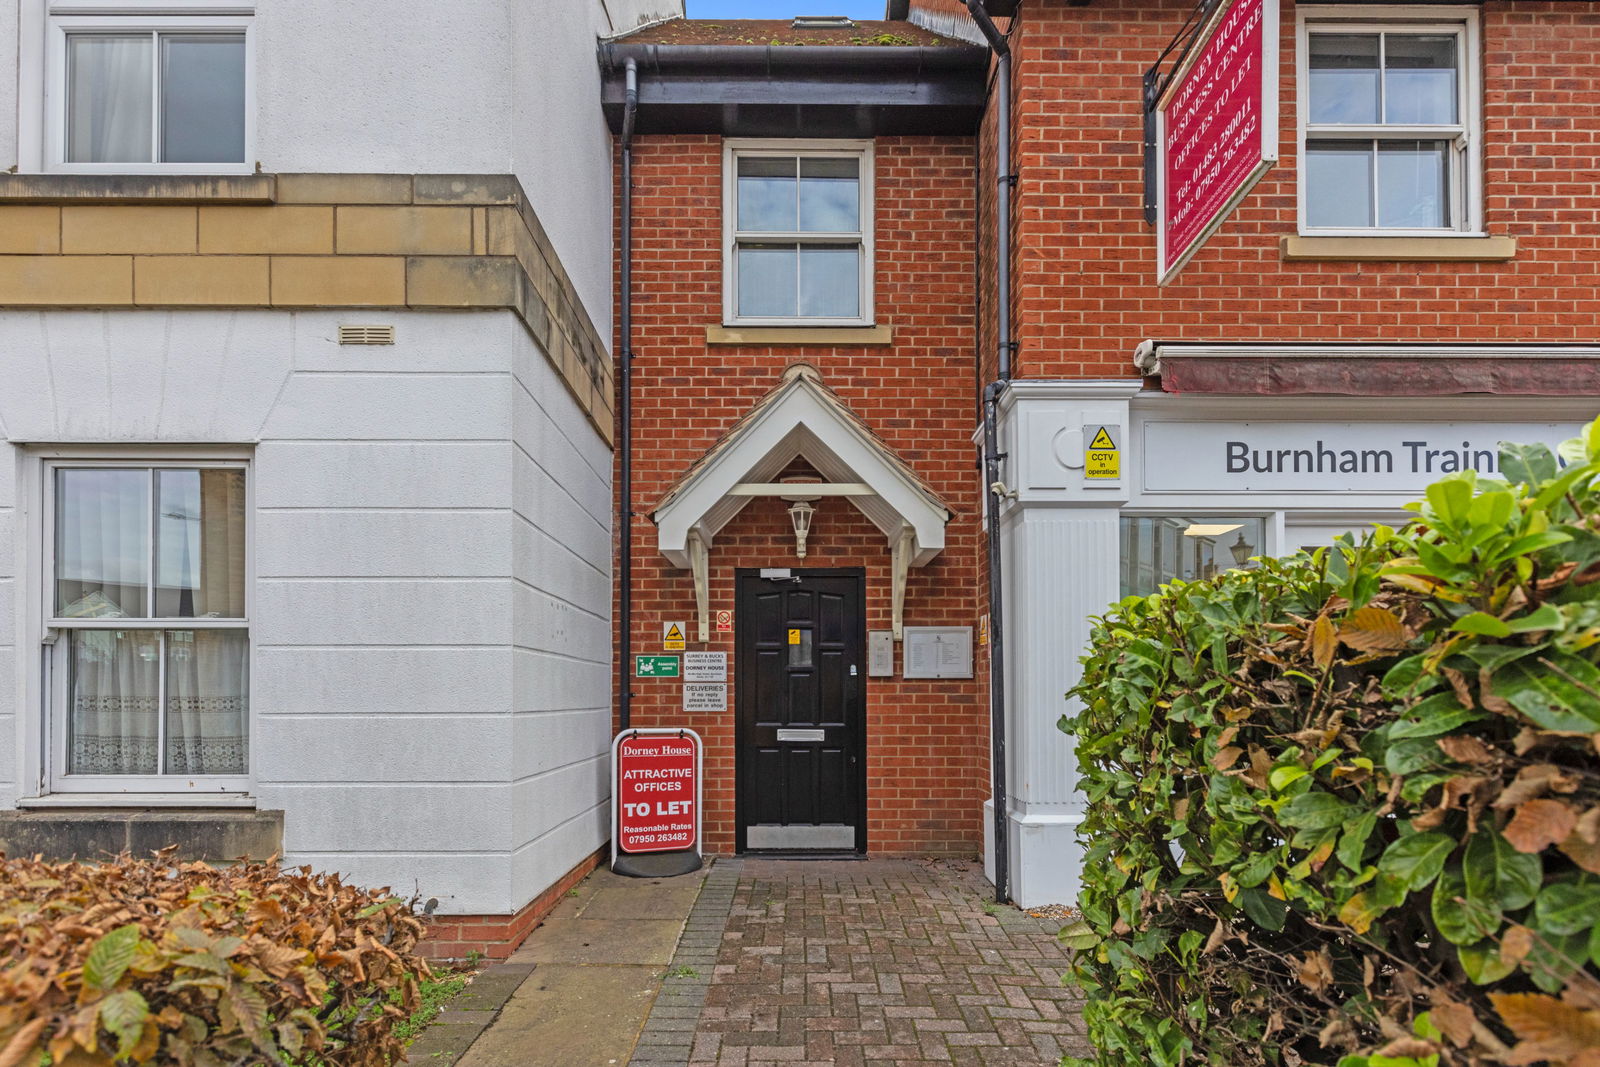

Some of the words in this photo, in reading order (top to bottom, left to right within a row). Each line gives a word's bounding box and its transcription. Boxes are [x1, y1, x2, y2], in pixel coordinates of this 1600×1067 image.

[1172, 48, 1214, 119] DORNEY
[1216, 0, 1251, 53] HOUS
[1168, 77, 1212, 151] BUSINESS
[1215, 2, 1262, 80] CENTRE
[1175, 110, 1212, 169] OFFICES
[1215, 89, 1229, 115] TO
[1231, 52, 1252, 94] LET
[1176, 181, 1191, 203] Tel:
[1192, 142, 1217, 182] 01483
[1220, 96, 1251, 149] 280011
[1173, 198, 1193, 229] Mob:
[1195, 161, 1220, 200] 07950
[1222, 115, 1256, 168] 263482
[1091, 453, 1114, 461] CCTV
[1226, 440, 1393, 473] Burnham
[623, 746, 660, 757] Dorney
[662, 745, 692, 755] House
[624, 768, 692, 779] ATTRACTIVE
[634, 781, 682, 792] OFFICES
[624, 802, 650, 817] TO
[656, 800, 692, 815] LET
[624, 824, 669, 833] Reasonable
[671, 823, 692, 831] Rates
[629, 835, 655, 844] 07950
[657, 833, 687, 843] 263482
